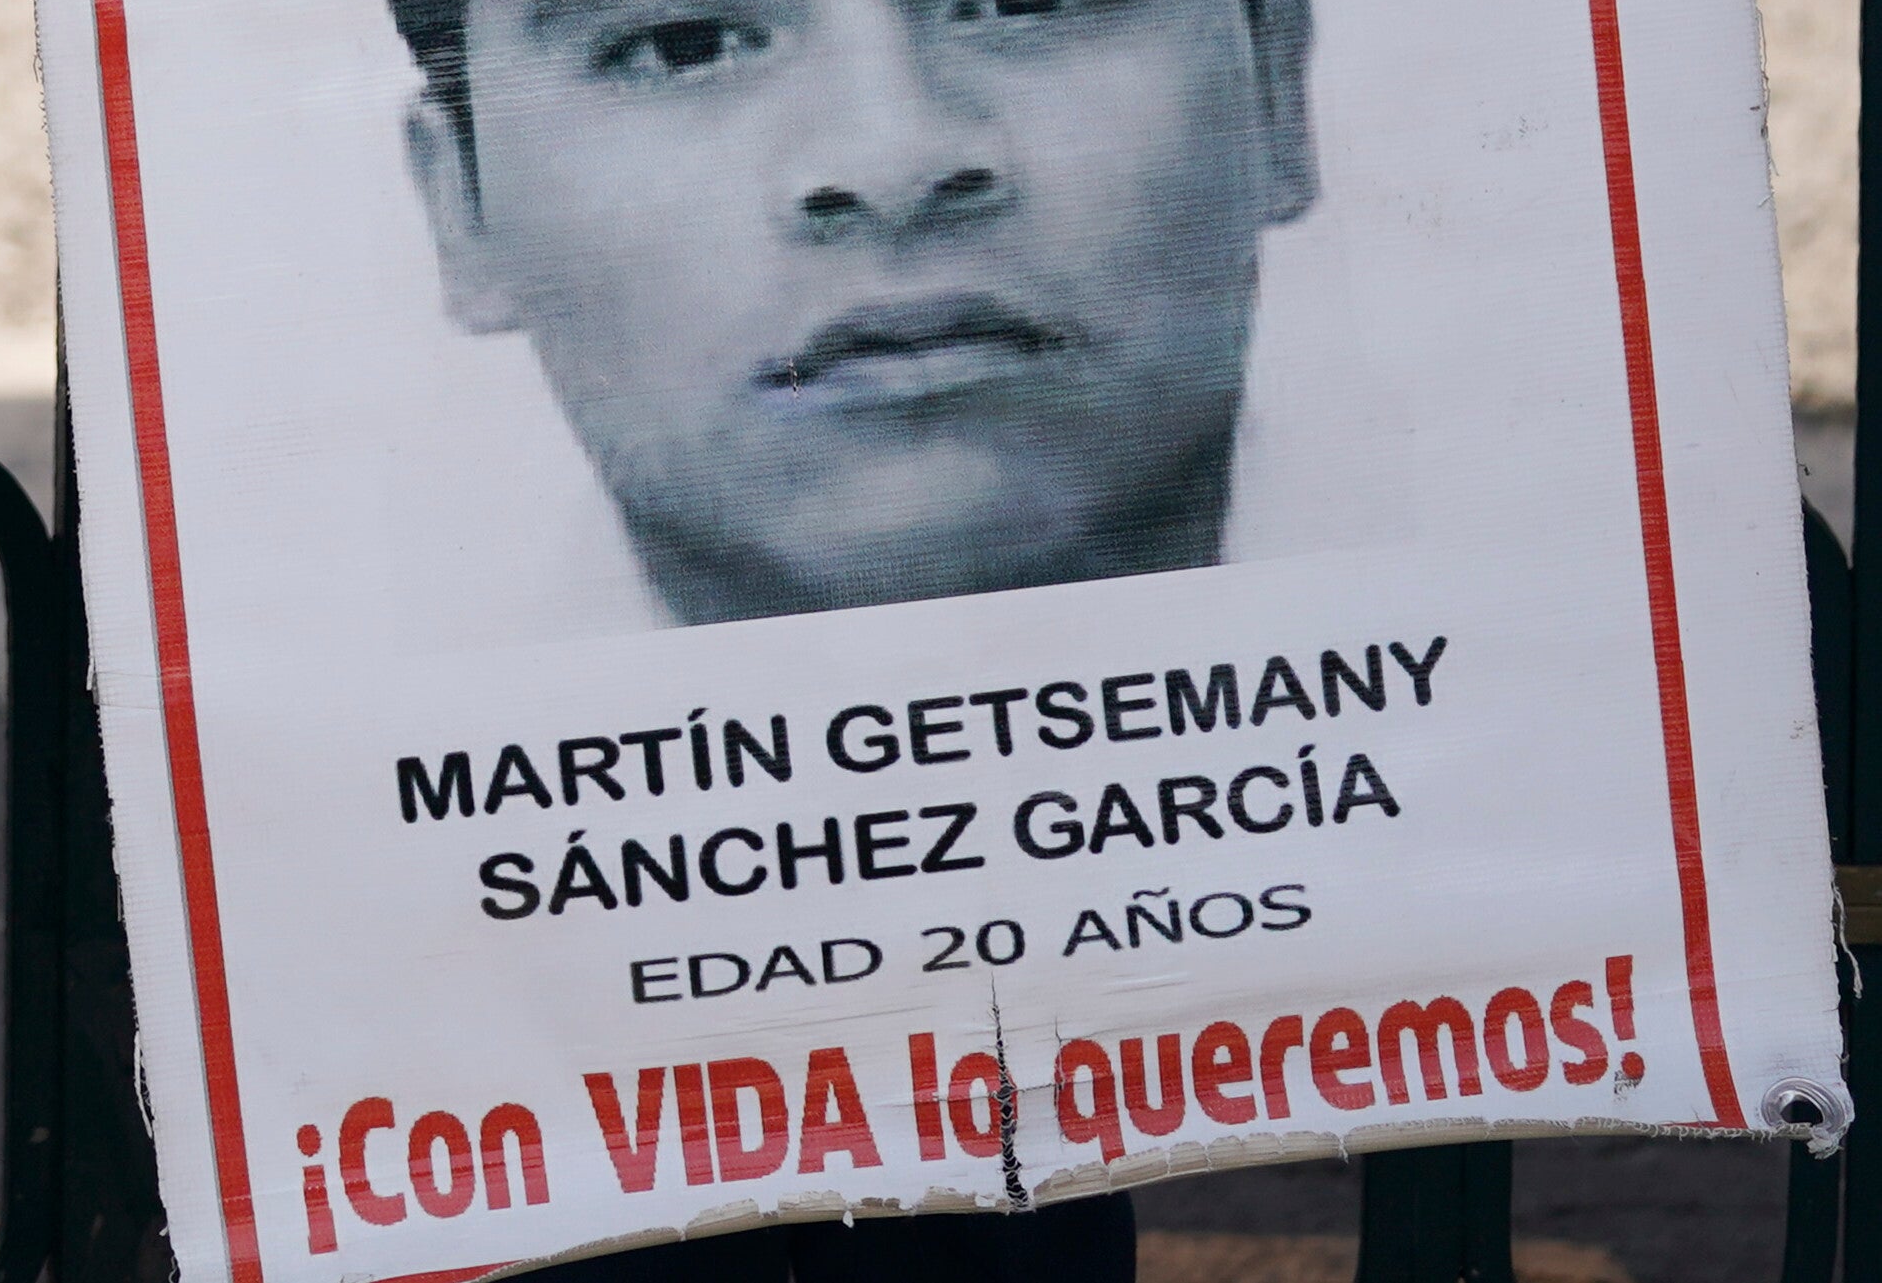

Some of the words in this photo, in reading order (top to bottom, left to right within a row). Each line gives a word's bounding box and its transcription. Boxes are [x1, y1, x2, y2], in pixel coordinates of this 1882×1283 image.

[395, 706, 793, 825] MARTÍN
[824, 636, 1449, 774] GETSEMANY
[479, 801, 986, 921] SÁNCHEZ
[1013, 742, 1402, 861] GARCÍA
[629, 936, 883, 1005] EDAD
[919, 918, 1027, 973] 20
[1060, 884, 1314, 960] AÑOS
[296, 1095, 551, 1256] ¡Con
[582, 1046, 884, 1193] VIDA
[907, 1032, 1018, 1162] lo
[1054, 954, 1646, 1165] queremos!
